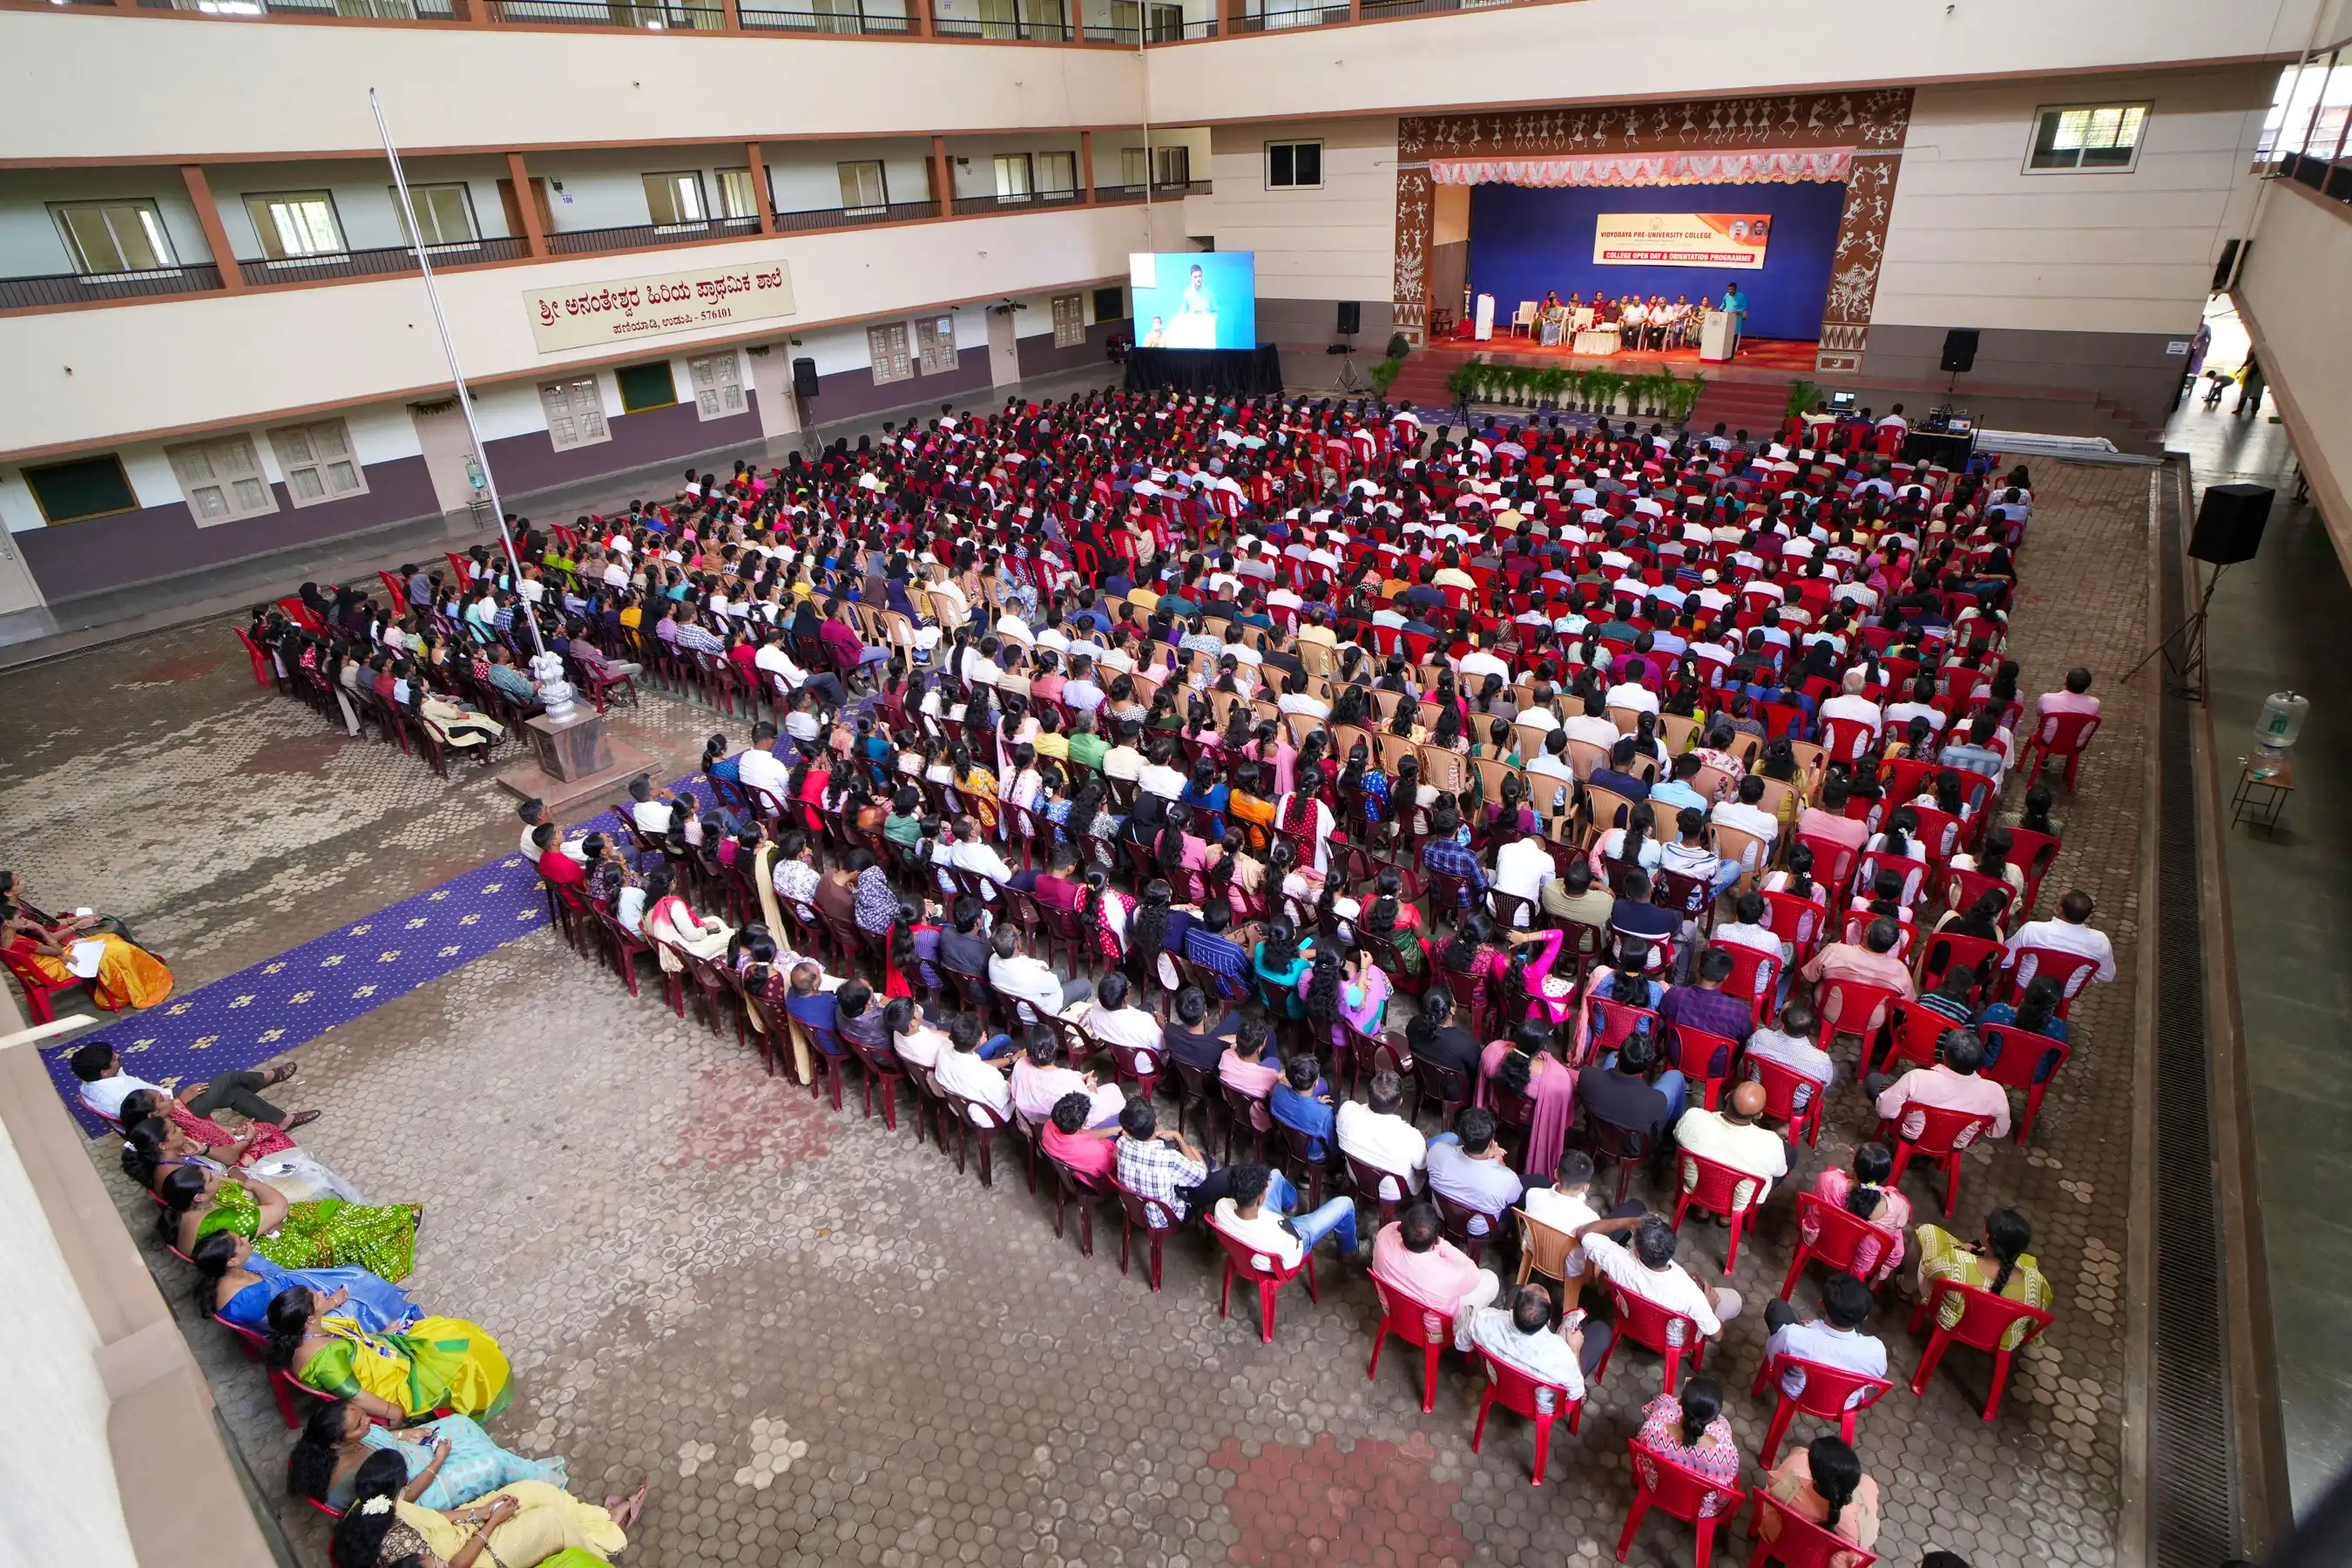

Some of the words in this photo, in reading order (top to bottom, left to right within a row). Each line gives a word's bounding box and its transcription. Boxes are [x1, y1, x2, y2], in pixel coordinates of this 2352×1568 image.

[1710, 253, 1753, 262] PROGRAMME
[538, 299, 562, 327] ಶ್ರೀ
[565, 285, 640, 318] ಅನಂತೇಶ್ವರ
[646, 278, 691, 305] ಹಿರಿಯ
[696, 271, 751, 305] ಪ್ರಾಥಮಿಕ
[756, 267, 782, 290] ಶಾಲೆ
[662, 314, 693, 328] ಉಡುಪಿ
[700, 308, 732, 321] 576101
